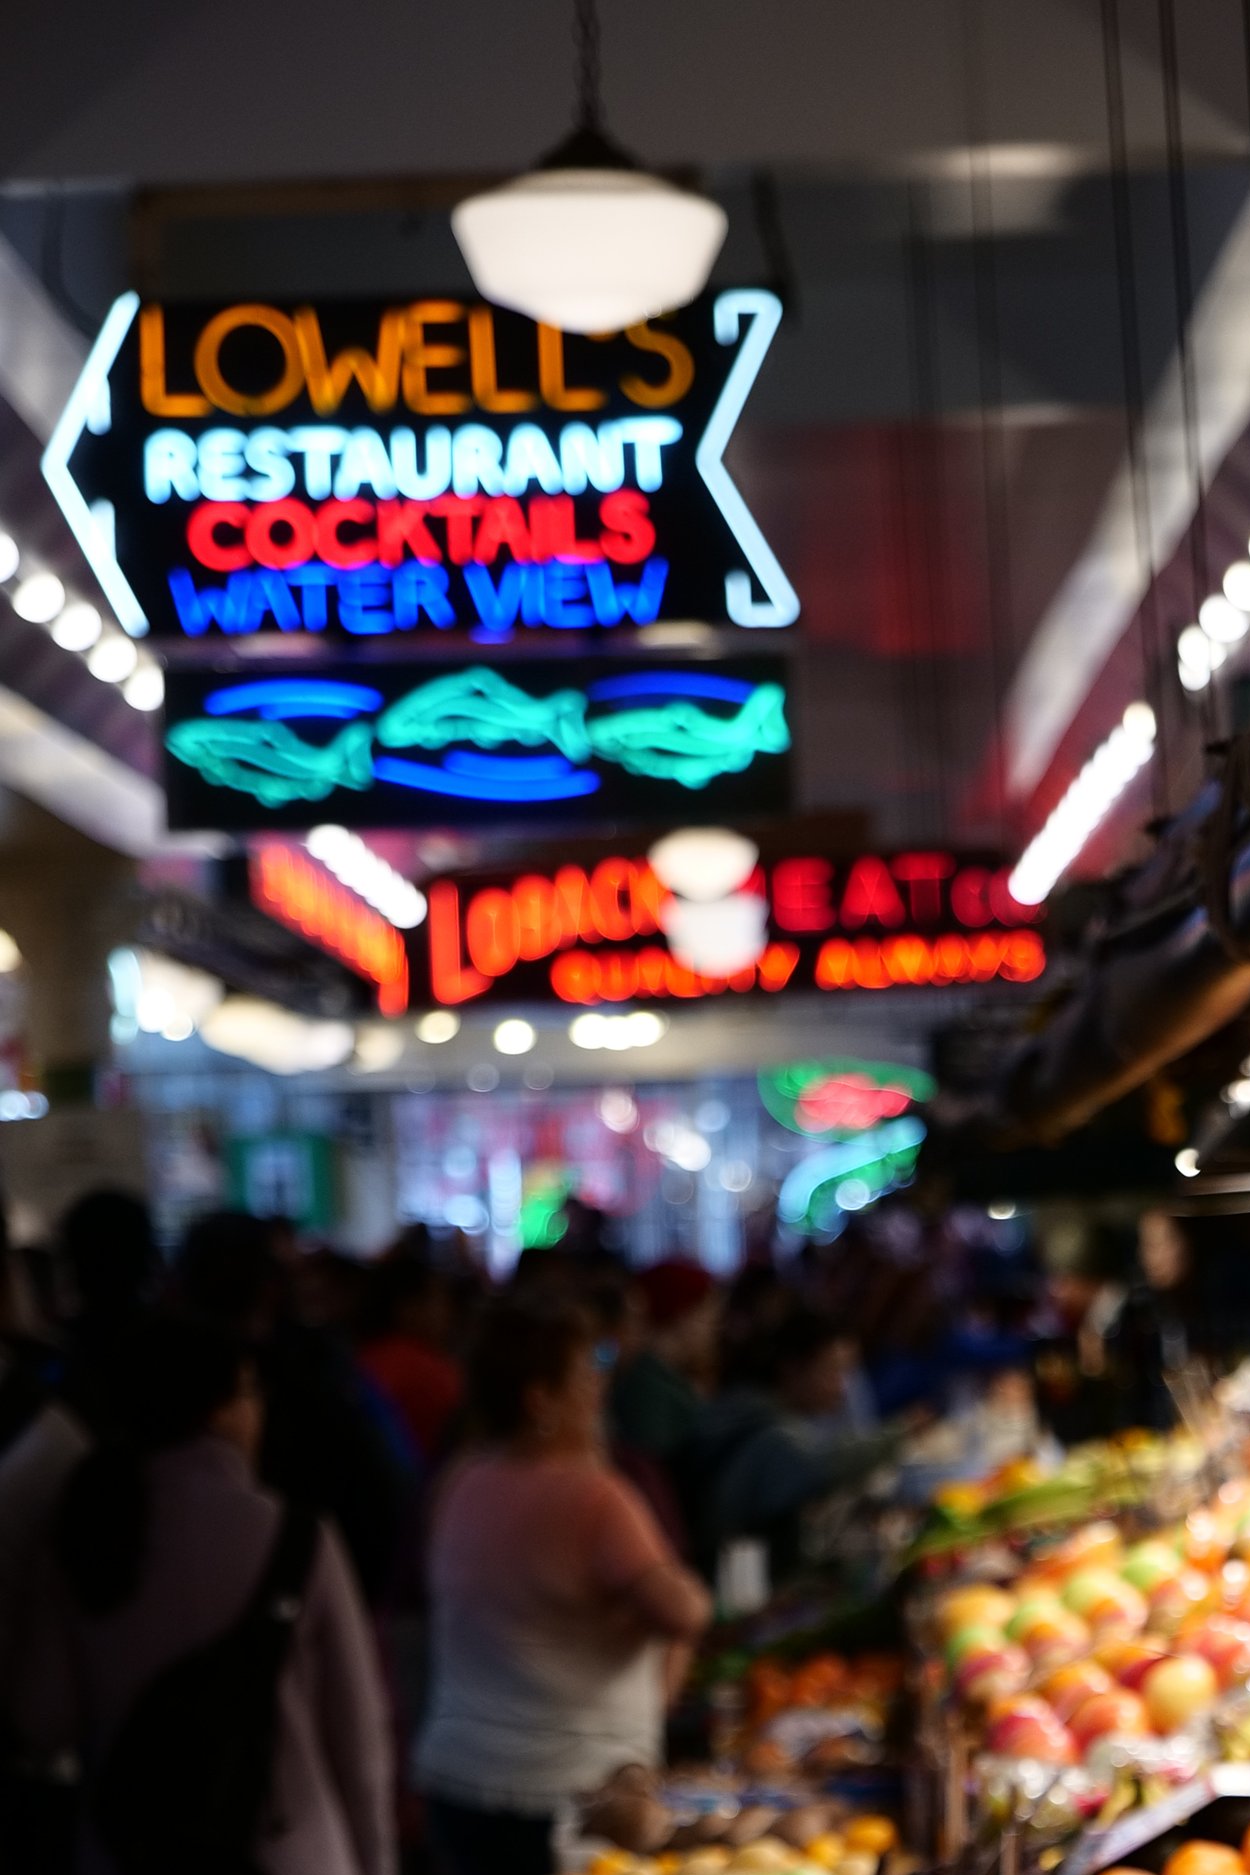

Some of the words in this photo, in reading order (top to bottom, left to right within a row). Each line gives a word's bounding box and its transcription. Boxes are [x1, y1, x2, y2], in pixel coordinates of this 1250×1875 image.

[140, 301, 695, 417] LOWELLS
[144, 416, 683, 504] RESTAURANT
[186, 489, 656, 572] COCKTAILS
[167, 561, 457, 639] WATER
[462, 556, 670, 634] VIEW
